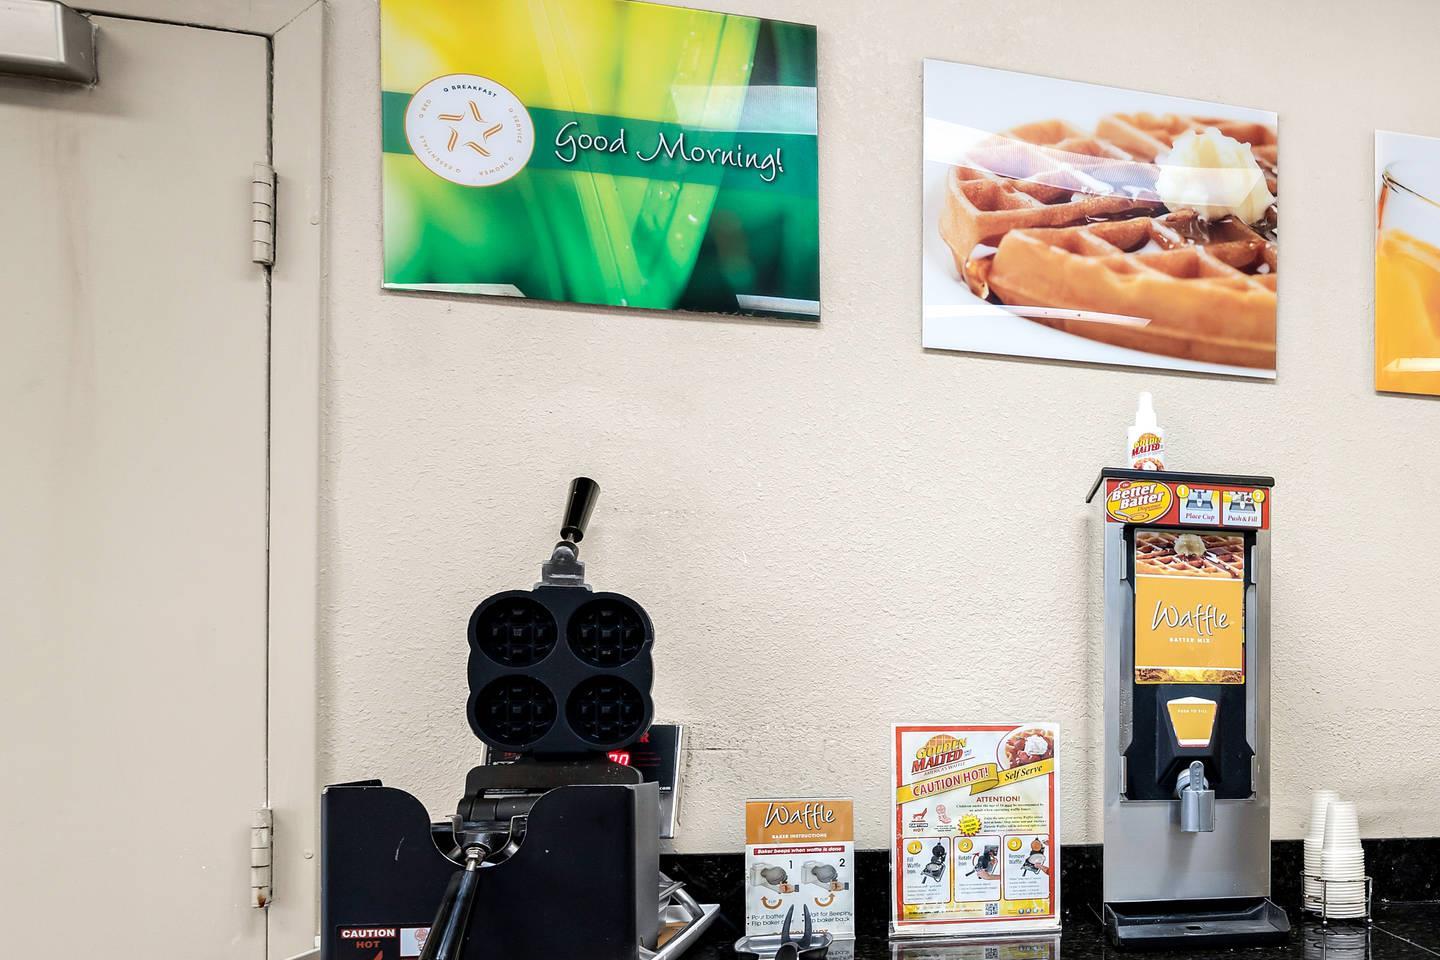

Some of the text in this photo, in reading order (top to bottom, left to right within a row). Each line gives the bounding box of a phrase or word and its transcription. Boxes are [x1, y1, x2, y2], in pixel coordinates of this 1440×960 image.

[451, 84, 497, 98] BREAKFAST
[555, 121, 784, 182] Good Morning!
[1131, 443, 1160, 456] MALTED
[1111, 483, 1157, 502] Better
[1119, 491, 1165, 510] Batter
[1185, 512, 1201, 520] Place
[1151, 600, 1230, 636] Waffle
[916, 738, 967, 759] GOLDEN
[911, 749, 964, 773] MALTED
[1004, 765, 1043, 781] Self Serve
[913, 767, 989, 797] CAUTION HOT!
[764, 802, 836, 830] Waffle
[789, 860, 793, 869] 1
[839, 858, 845, 867] 2
[342, 929, 395, 938] CAUTION
[355, 940, 382, 949] HOT
